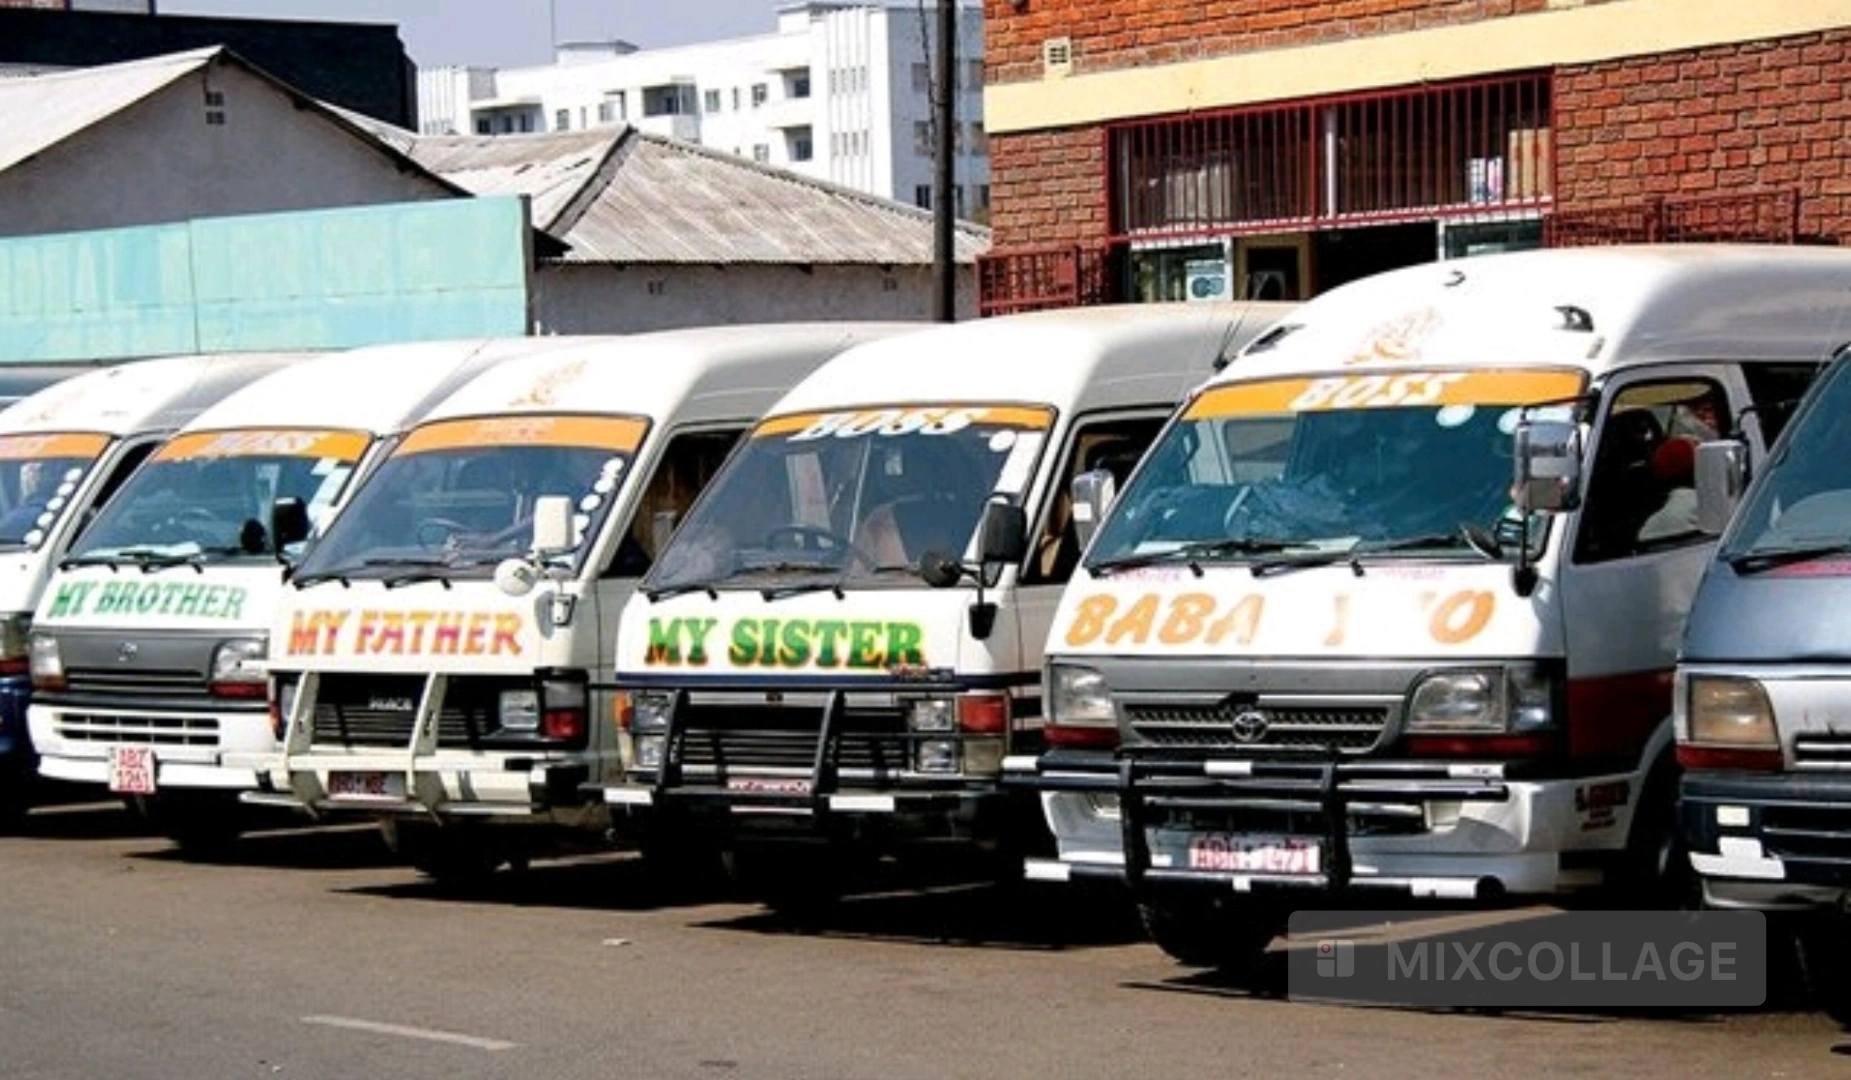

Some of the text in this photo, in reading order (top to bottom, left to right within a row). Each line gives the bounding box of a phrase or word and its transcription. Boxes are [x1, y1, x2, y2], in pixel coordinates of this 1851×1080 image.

[1288, 372, 1470, 410] BOSS
[787, 407, 990, 441] BOSS
[48, 580, 247, 620] MY BROTHER
[1065, 593, 1264, 647] BABA
[287, 608, 523, 656] MY FATHER
[645, 617, 926, 669] MY SISTER
